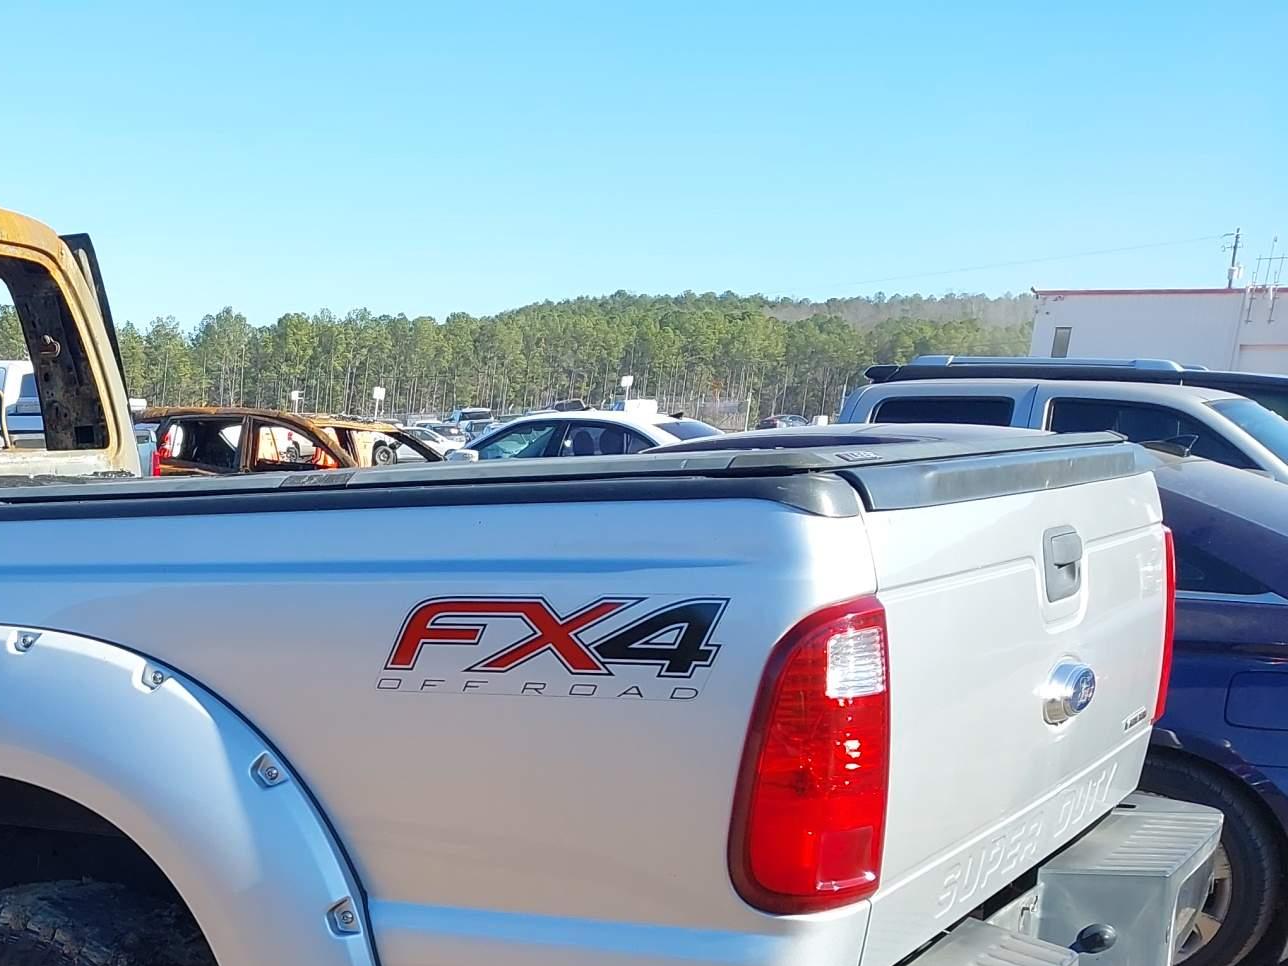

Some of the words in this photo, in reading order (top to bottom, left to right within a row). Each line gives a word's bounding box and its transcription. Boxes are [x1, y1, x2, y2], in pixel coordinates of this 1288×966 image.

[384, 596, 731, 678] FX4
[377, 678, 489, 693] OFF
[520, 681, 699, 700] ROAD
[934, 812, 1044, 918] SUPER
[1053, 761, 1118, 838] DUTY
